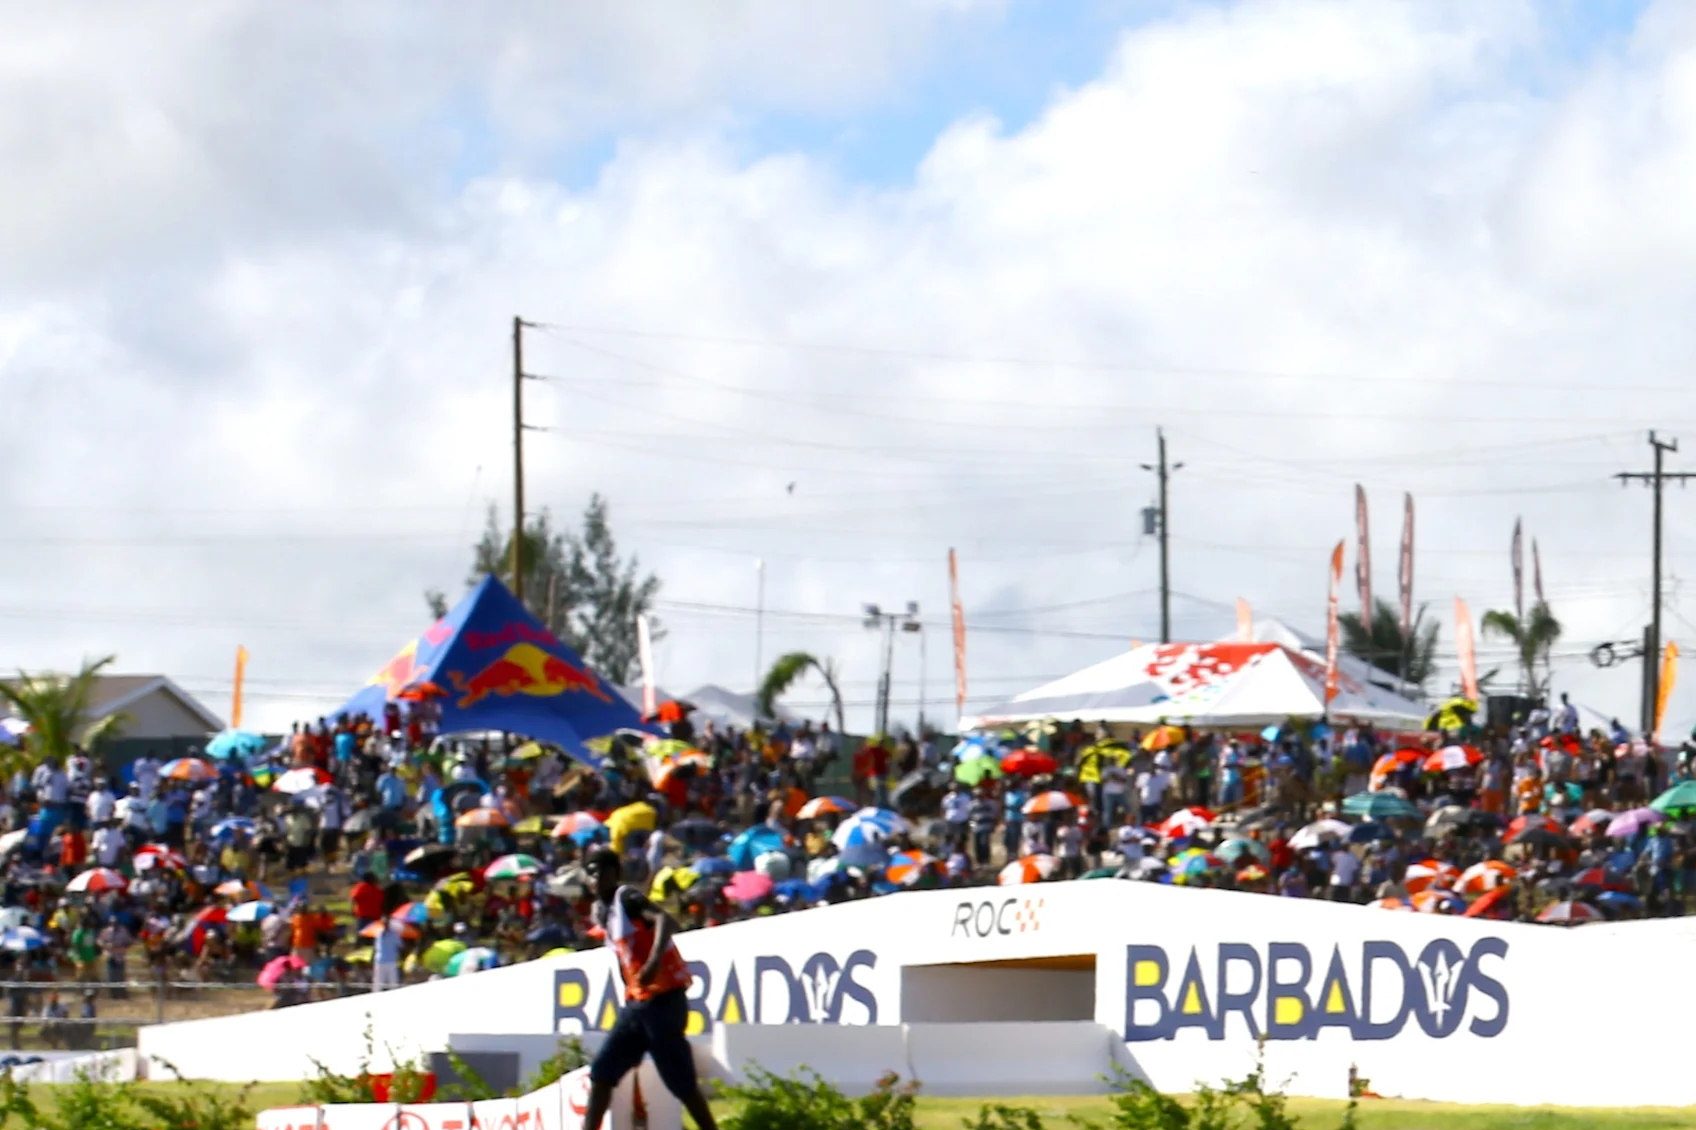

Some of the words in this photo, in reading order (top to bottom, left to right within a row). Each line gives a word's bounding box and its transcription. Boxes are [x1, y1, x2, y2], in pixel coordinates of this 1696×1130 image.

[951, 898, 1017, 938] ROC
[553, 949, 878, 1034] BABADOS
[1125, 936, 1510, 1042] BARBADOS
